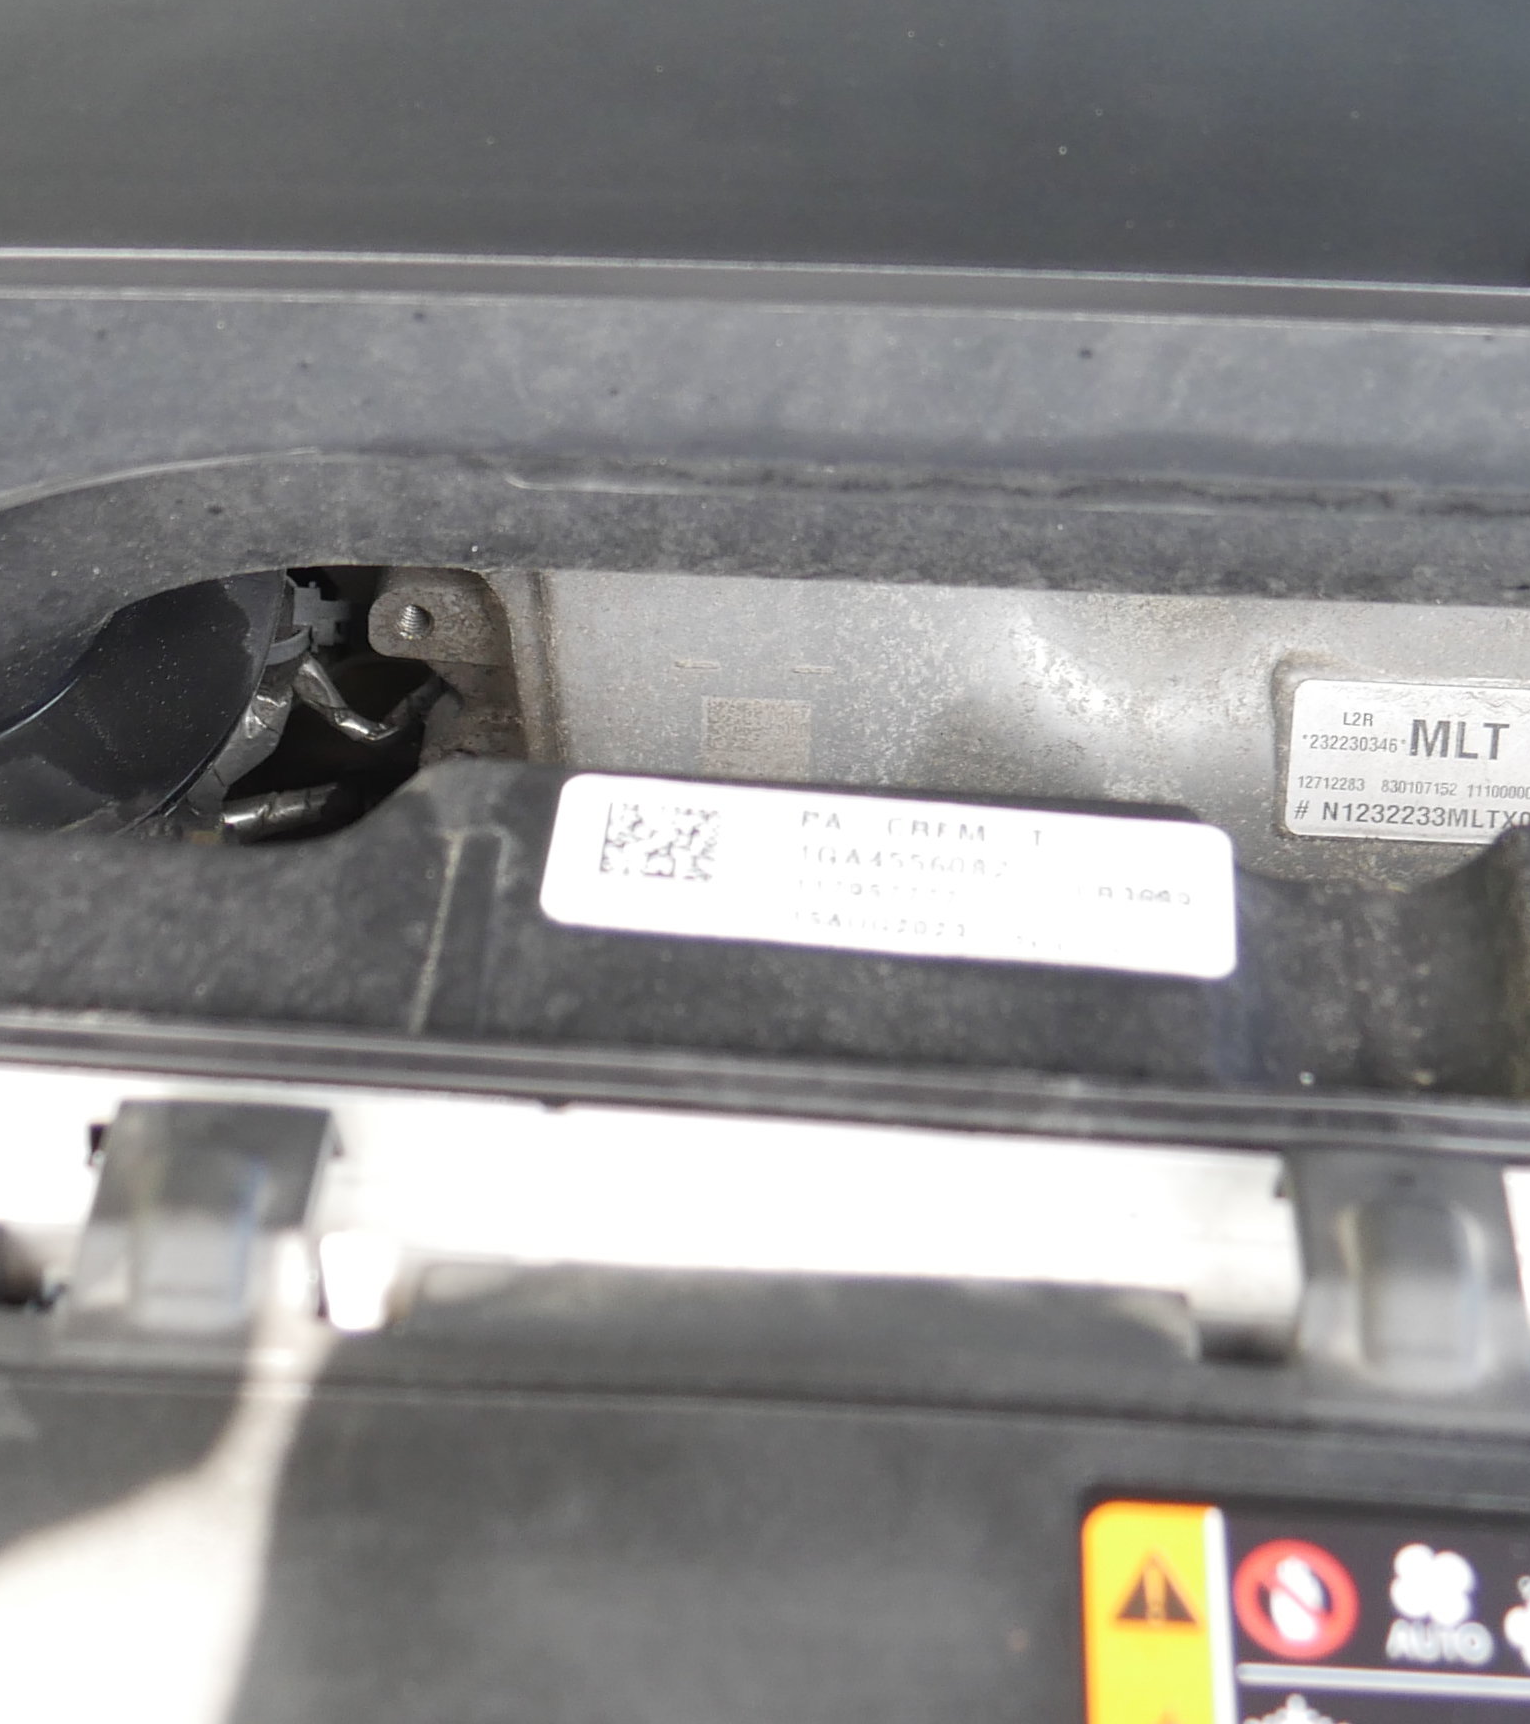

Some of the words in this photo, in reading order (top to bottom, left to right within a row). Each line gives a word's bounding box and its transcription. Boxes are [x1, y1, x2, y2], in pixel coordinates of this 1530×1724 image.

[1342, 711, 1374, 728] L2R
[1408, 718, 1511, 761] MLT
[1297, 775, 1366, 792] 12712283
[1380, 779, 1458, 797] 830107152
[1294, 799, 1310, 820] #
[1385, 1617, 1494, 1667] AUTO
